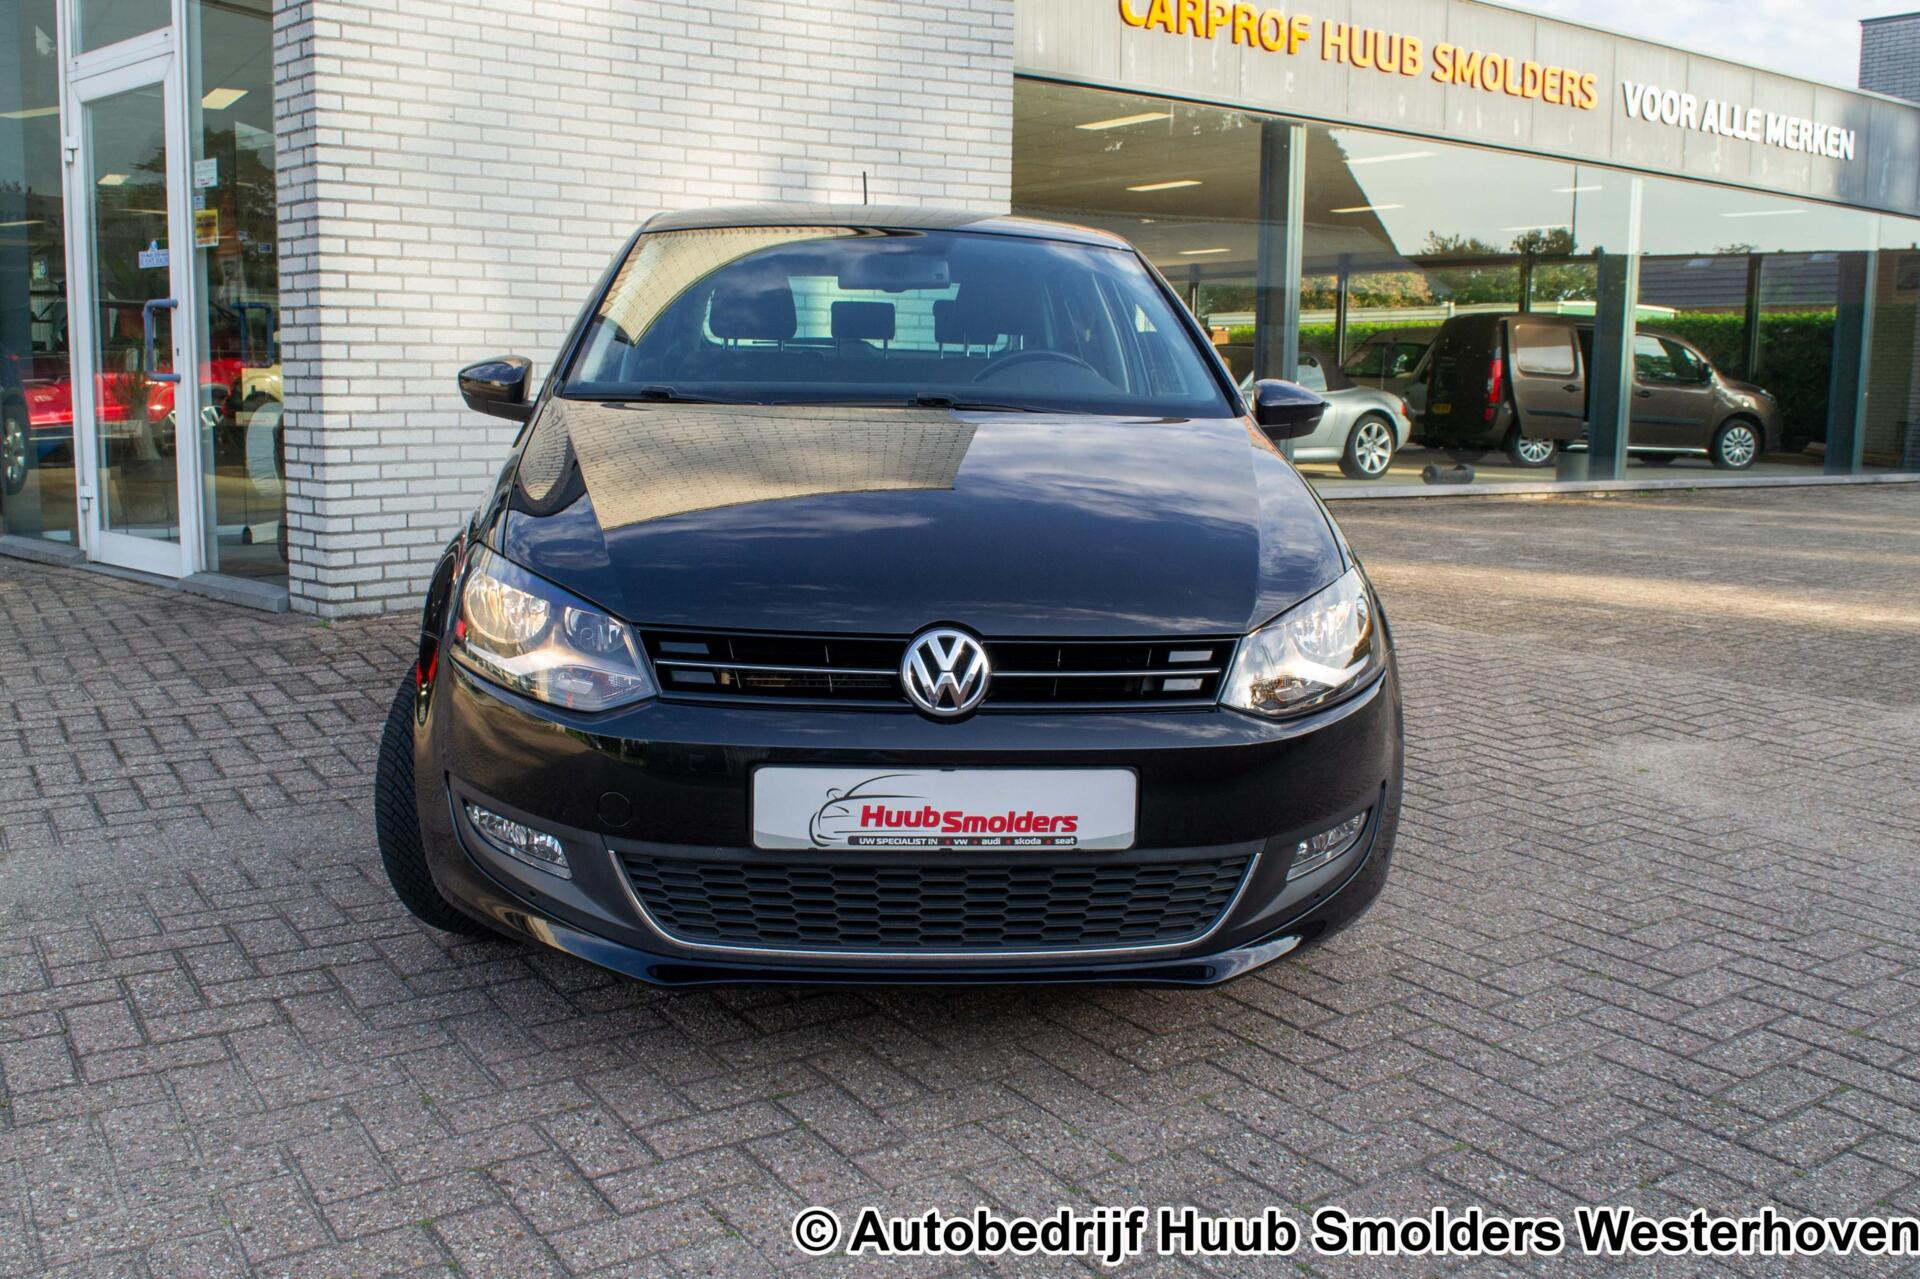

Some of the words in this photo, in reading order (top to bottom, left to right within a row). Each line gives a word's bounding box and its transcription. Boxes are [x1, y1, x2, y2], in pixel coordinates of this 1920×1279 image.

[1118, 0, 1312, 54] CARPROF
[1322, 18, 1425, 76] HUUB
[1431, 42, 1599, 111] SMOLDERS
[1622, 80, 1697, 131] VOOR
[1701, 98, 1763, 143] ALLE
[1764, 111, 1856, 161] MERKEN
[859, 837, 877, 845] UW
[876, 837, 927, 845] SPECIALIST
[927, 837, 938, 845] IN
[981, 836, 1001, 845] audi
[1014, 836, 1042, 845] skoda
[1055, 837, 1075, 845] seat
[860, 805, 941, 828] Huub
[940, 811, 1079, 833] Smolders
